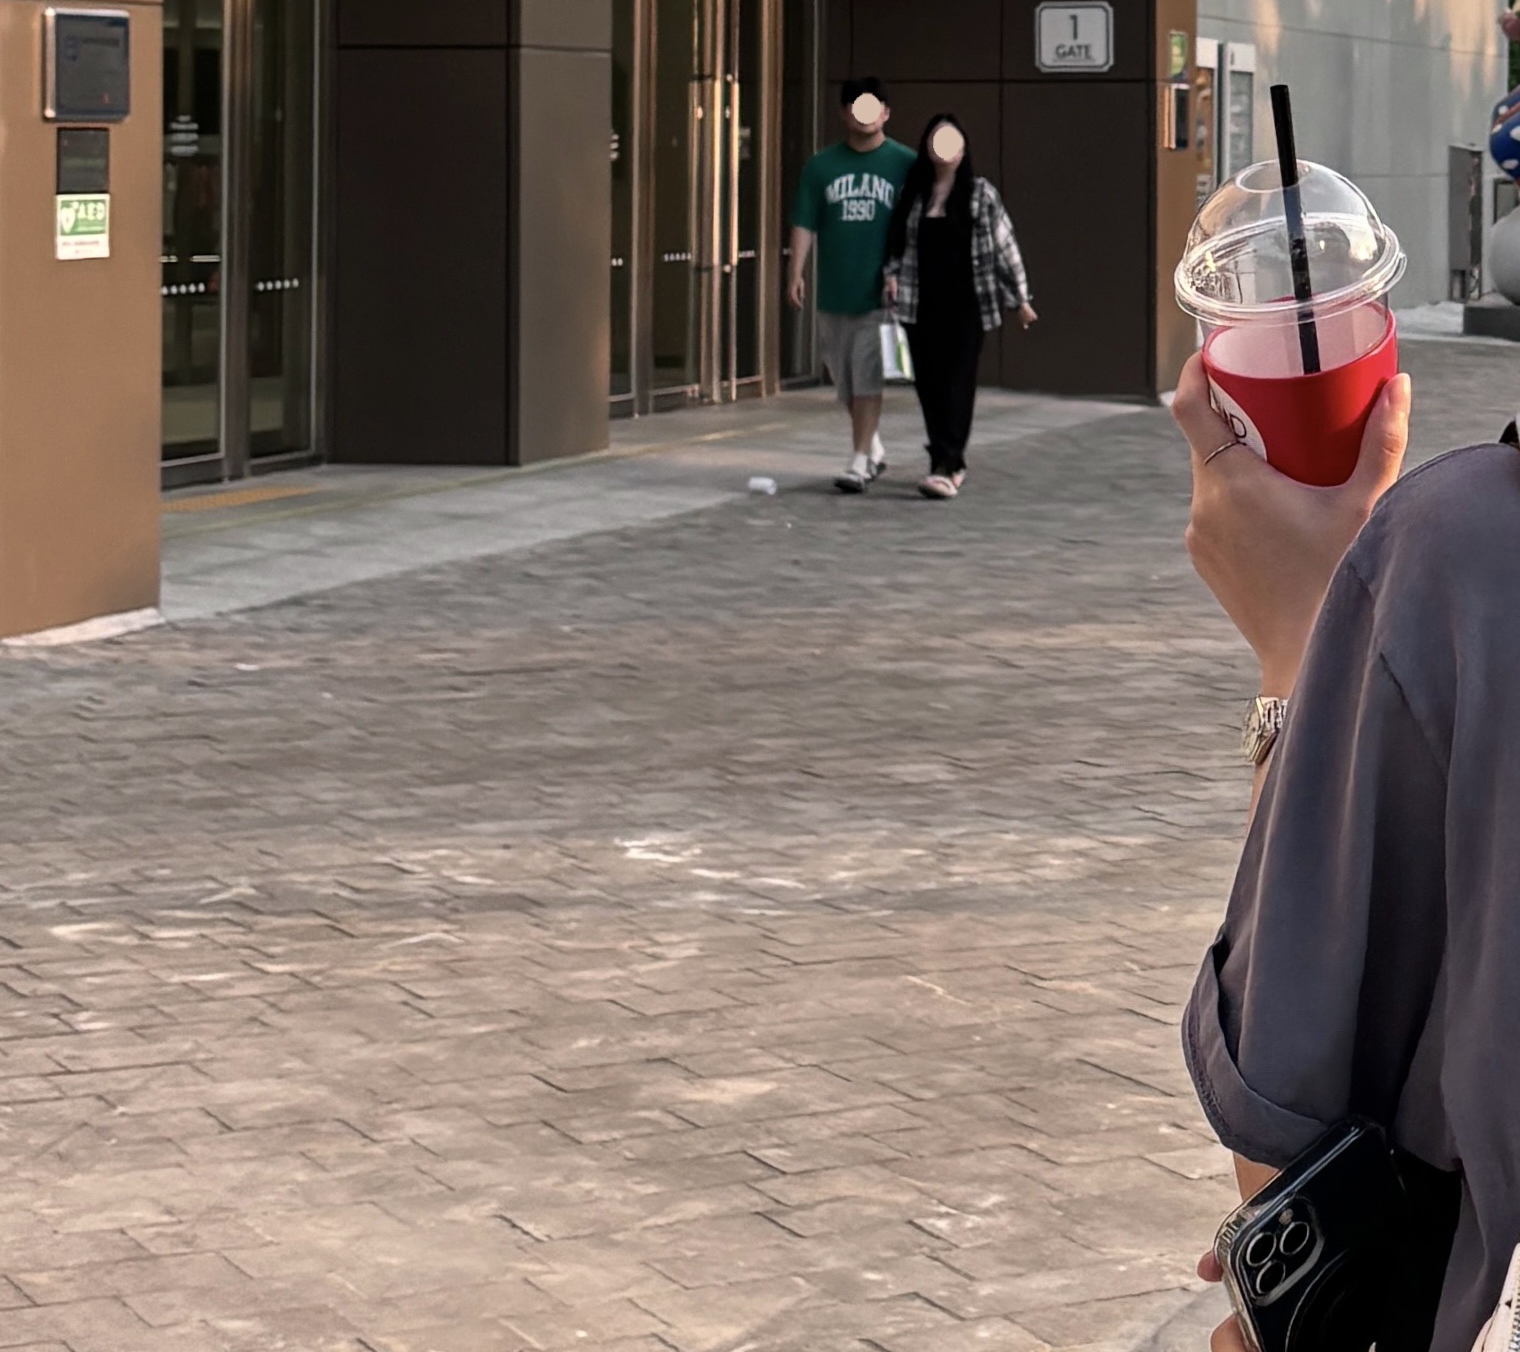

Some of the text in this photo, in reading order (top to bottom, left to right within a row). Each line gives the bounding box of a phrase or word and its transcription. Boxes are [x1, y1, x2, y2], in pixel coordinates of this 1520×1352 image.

[1068, 13, 1079, 40] 1
[1055, 43, 1093, 59] GATE
[824, 172, 896, 210] MILANO
[841, 198, 876, 222] 1990
